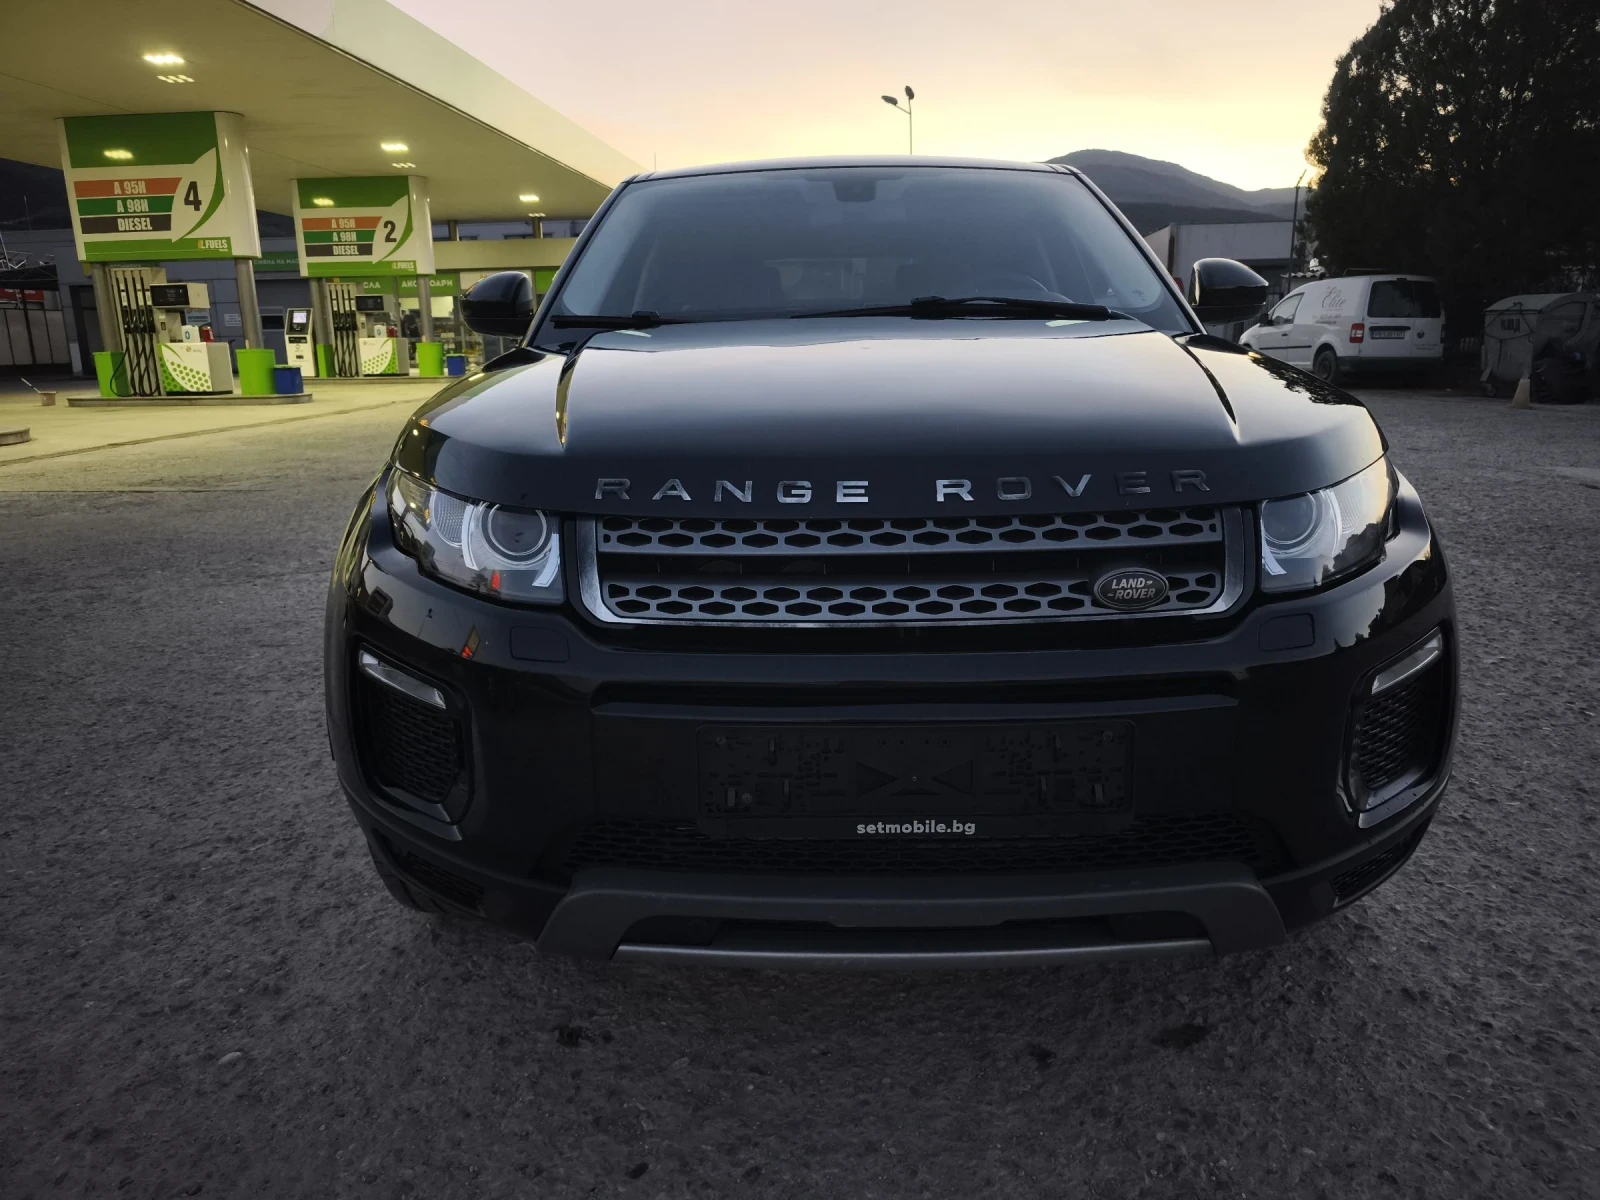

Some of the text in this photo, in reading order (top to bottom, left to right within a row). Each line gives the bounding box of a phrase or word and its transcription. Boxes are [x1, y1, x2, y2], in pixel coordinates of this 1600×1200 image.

[113, 181, 122, 195] A
[184, 181, 202, 211] 4
[116, 200, 125, 213] A
[117, 217, 153, 231] DIESEL
[383, 220, 398, 243] 2
[332, 245, 359, 255] DIESEL
[595, 469, 1210, 503] RANGE ROVER
[1111, 578, 1146, 589] LAND
[1114, 588, 1156, 600] ROVER
[856, 820, 976, 835] setmobile.bg
